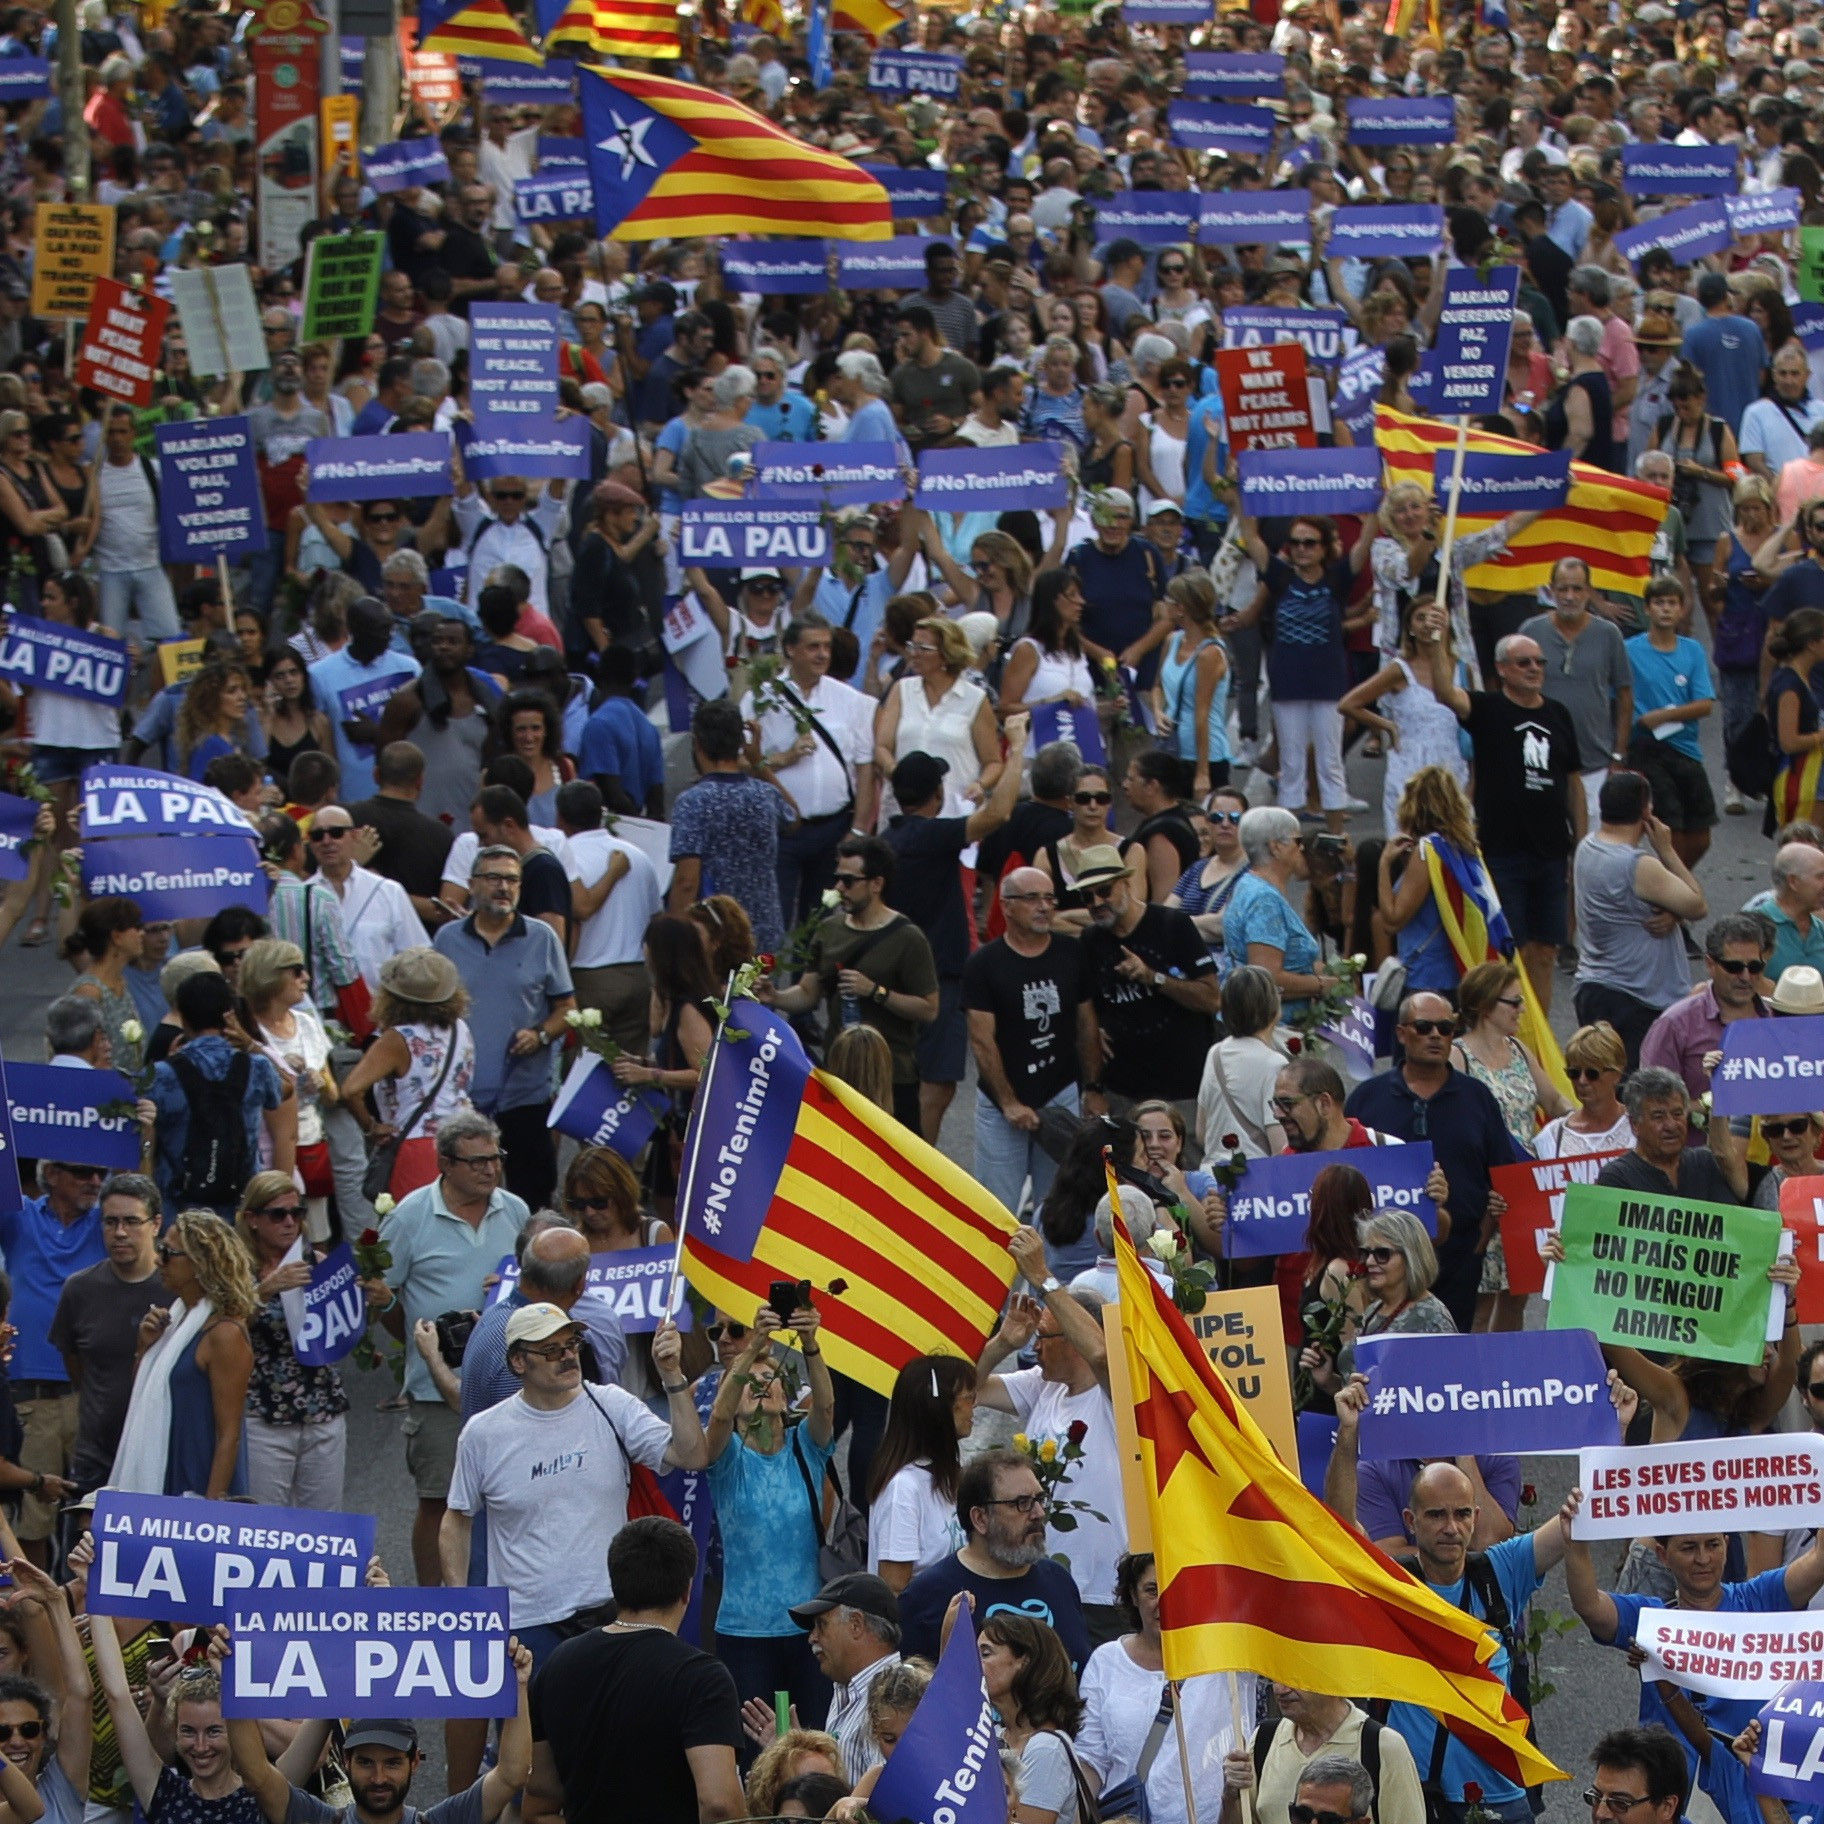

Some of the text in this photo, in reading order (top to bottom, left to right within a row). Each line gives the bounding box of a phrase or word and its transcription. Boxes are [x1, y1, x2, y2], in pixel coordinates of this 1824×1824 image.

[1449, 289, 1509, 304] MARIANO
[1440, 307, 1515, 325] QUEREMOS
[1461, 346, 1481, 360] NO
[1443, 364, 1495, 379] VENDER
[1443, 383, 1489, 397] ARMAS
[162, 433, 246, 454] MARIANO
[174, 453, 238, 471] VOLEM
[313, 457, 445, 479] #NoTenimPor
[922, 469, 1058, 491] #NoTenimPor
[195, 492, 223, 507] NO
[177, 507, 251, 527] VENDRE
[681, 511, 701, 523] LA
[704, 511, 755, 523] MILLOR
[187, 526, 249, 545] ARMES
[682, 525, 825, 558] LA PAU
[1372, 1379, 1598, 1415] #NoTenimPor
[235, 1611, 504, 1632] LA MILLOR RESPOSTA
[235, 1640, 505, 1698] LA PAU
